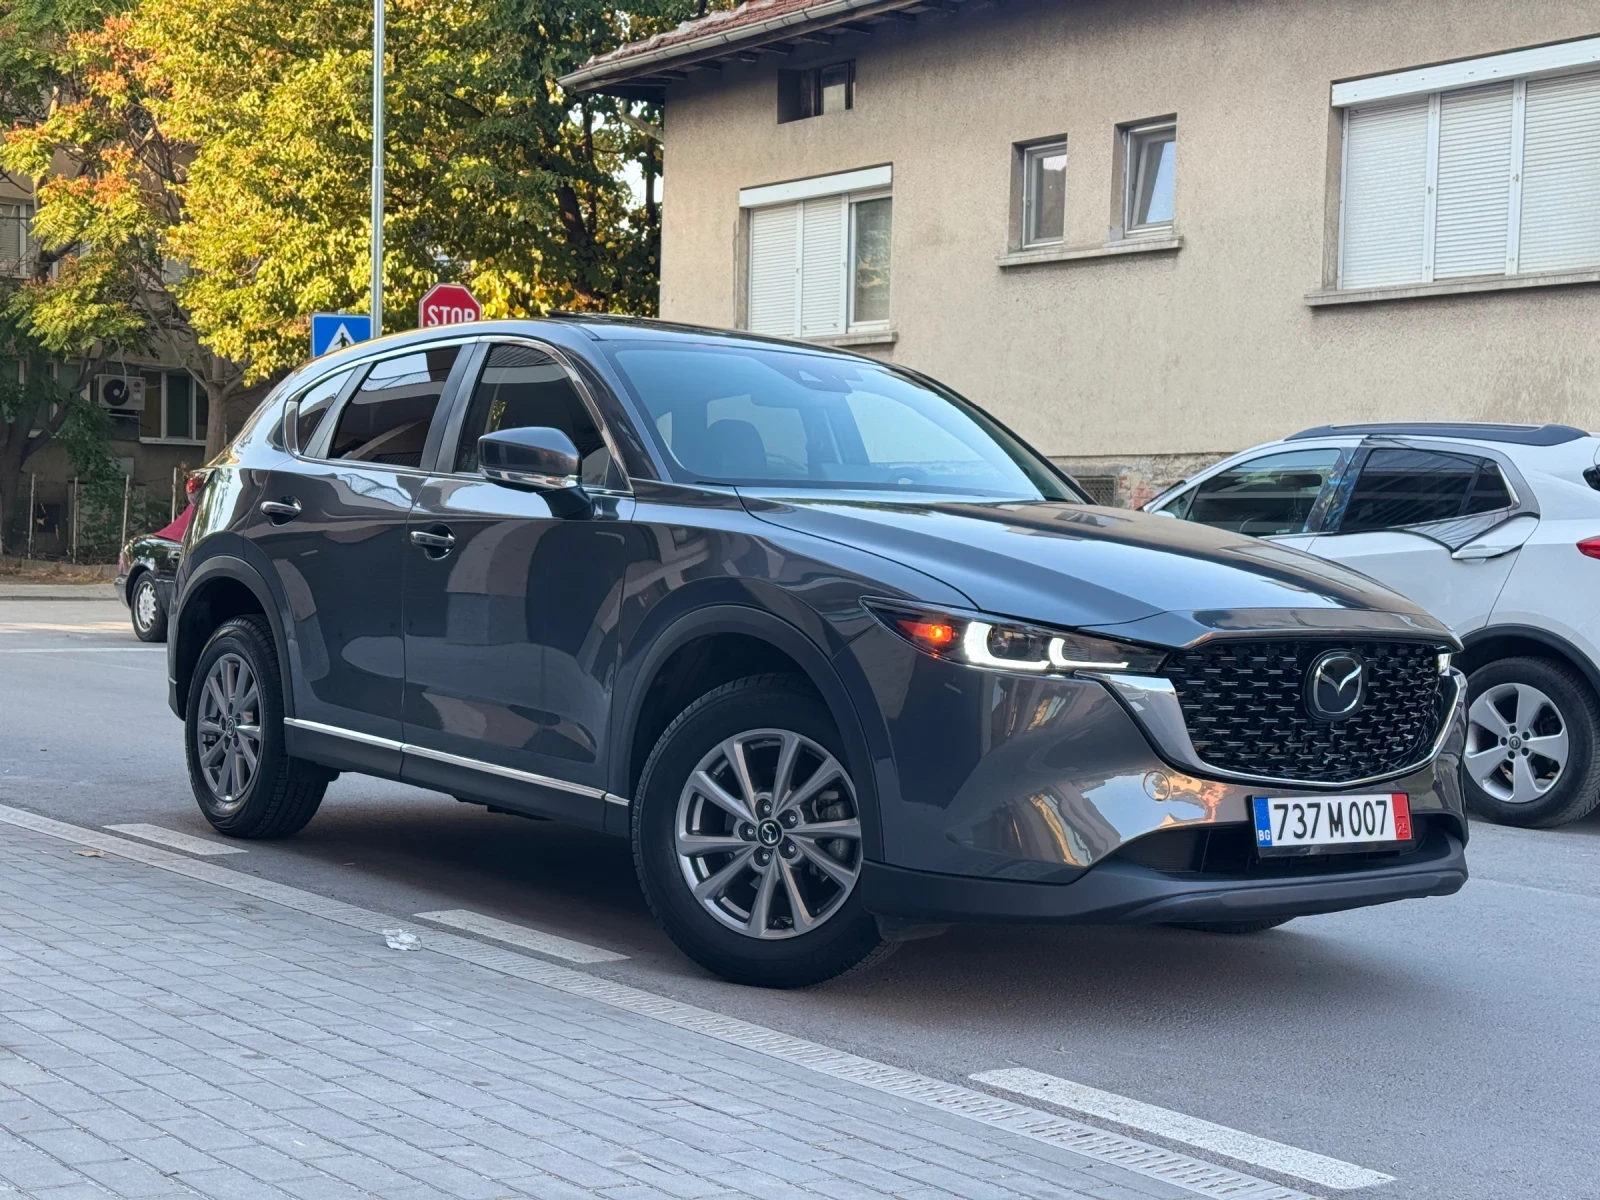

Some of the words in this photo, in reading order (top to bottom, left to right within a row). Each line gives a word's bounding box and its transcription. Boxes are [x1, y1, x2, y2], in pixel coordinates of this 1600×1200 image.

[428, 305, 476, 327] STOP
[1273, 801, 1321, 840] 737
[1327, 801, 1345, 838] M
[1349, 799, 1388, 837] 007
[1258, 829, 1271, 841] BG
